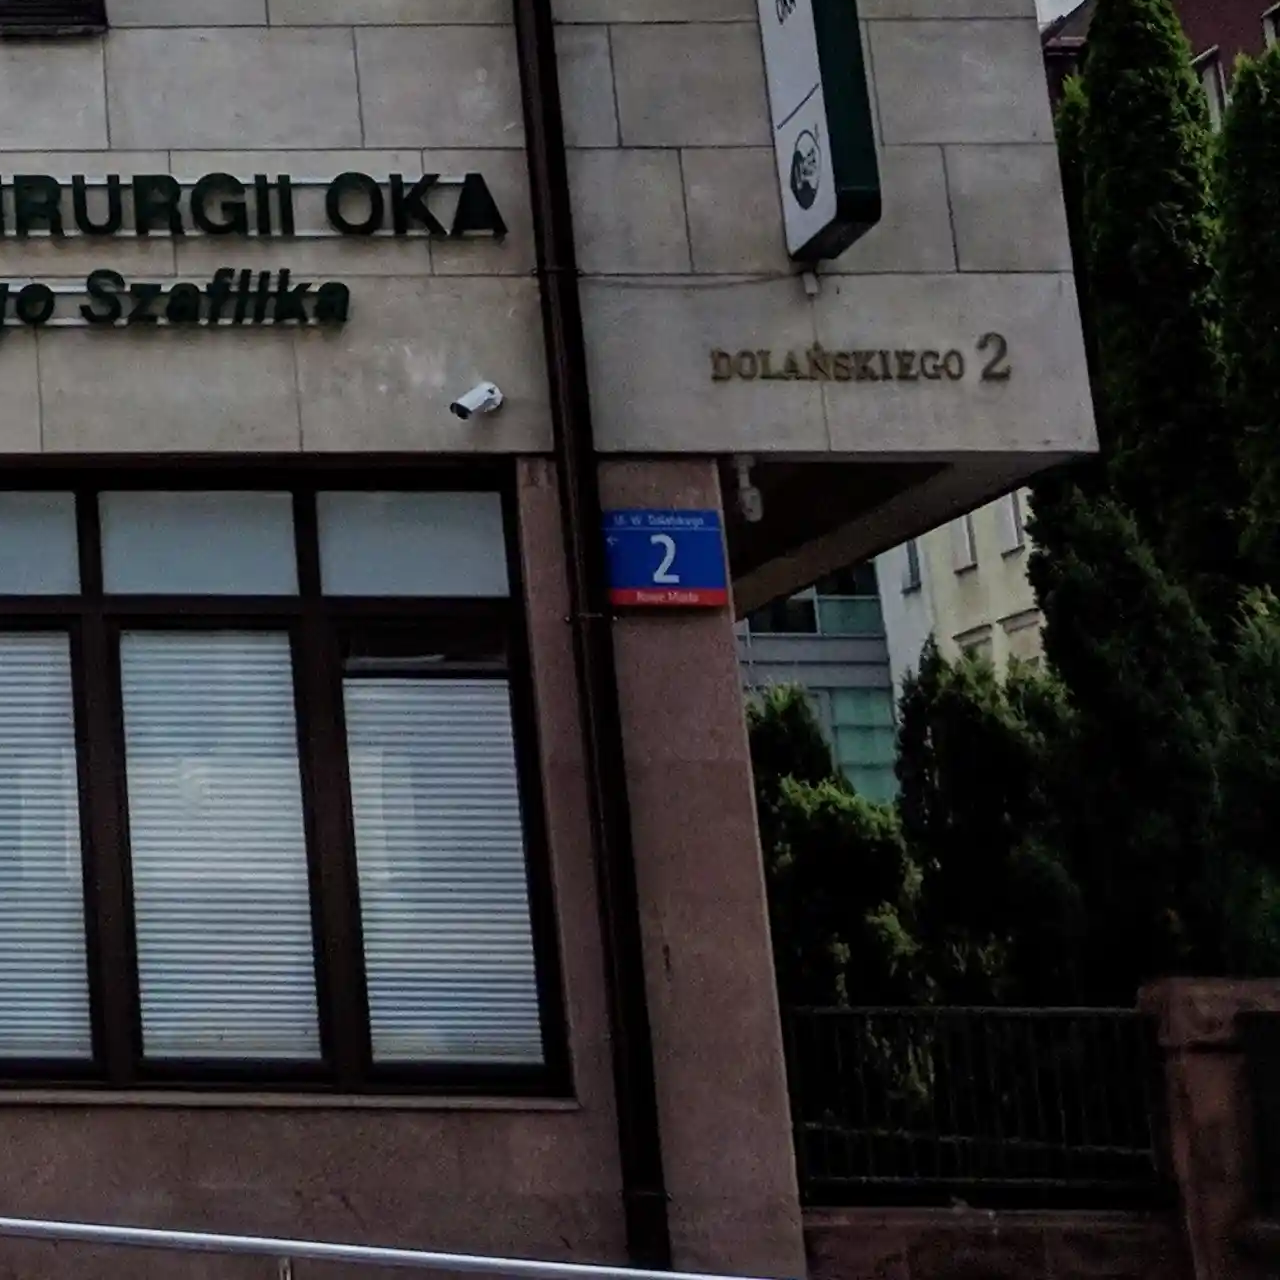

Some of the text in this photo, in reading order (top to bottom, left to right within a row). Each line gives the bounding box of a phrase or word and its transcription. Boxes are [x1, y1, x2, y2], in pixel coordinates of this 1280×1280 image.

[326, 169, 510, 241] OKA
[78, 266, 353, 330] Szaflika
[709, 331, 1012, 383] DOLAŃSKIEGO 2
[649, 533, 681, 584] 2
